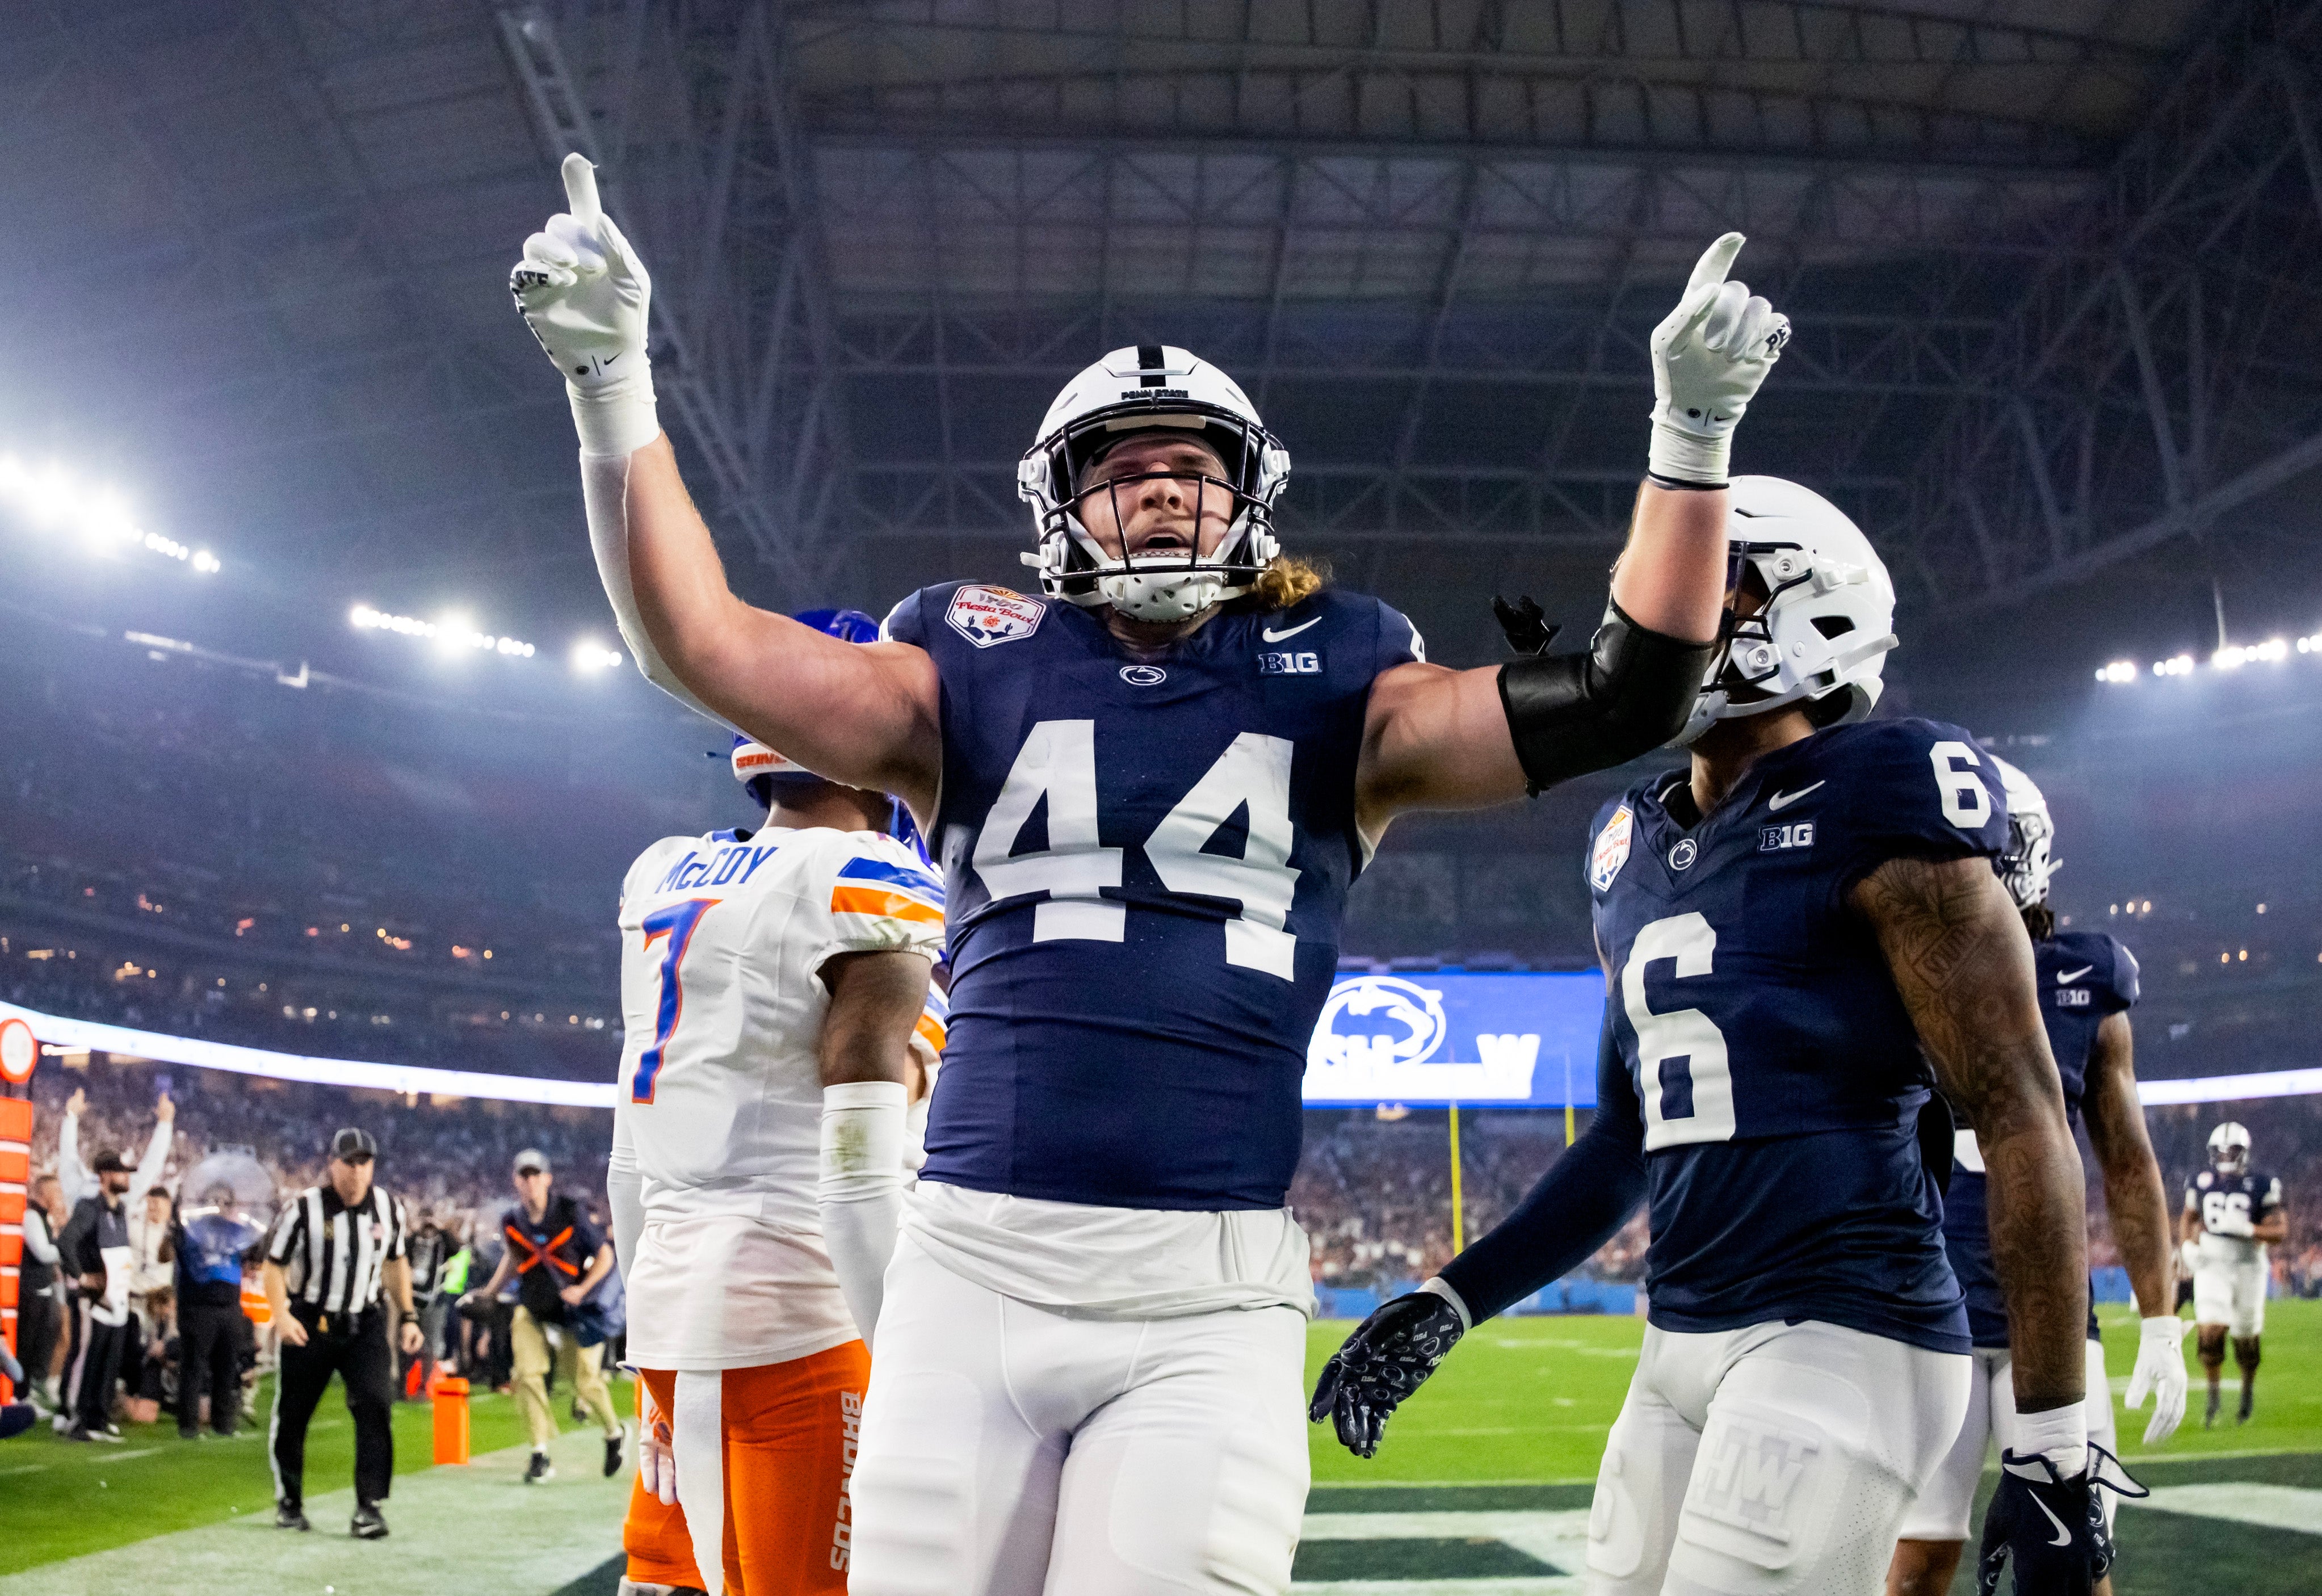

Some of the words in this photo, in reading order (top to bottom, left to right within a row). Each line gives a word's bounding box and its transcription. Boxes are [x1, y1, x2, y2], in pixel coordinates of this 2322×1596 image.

[1121, 388, 1153, 400] PENN
[1154, 389, 1189, 398] STATE
[956, 602, 997, 613] Fiesta
[998, 608, 1034, 624] Bowl
[1929, 741, 1991, 828] 6
[654, 846, 779, 894] McCOY
[972, 719, 1302, 982] 44
[632, 898, 724, 1104] 7
[1622, 912, 1736, 1152] 6
